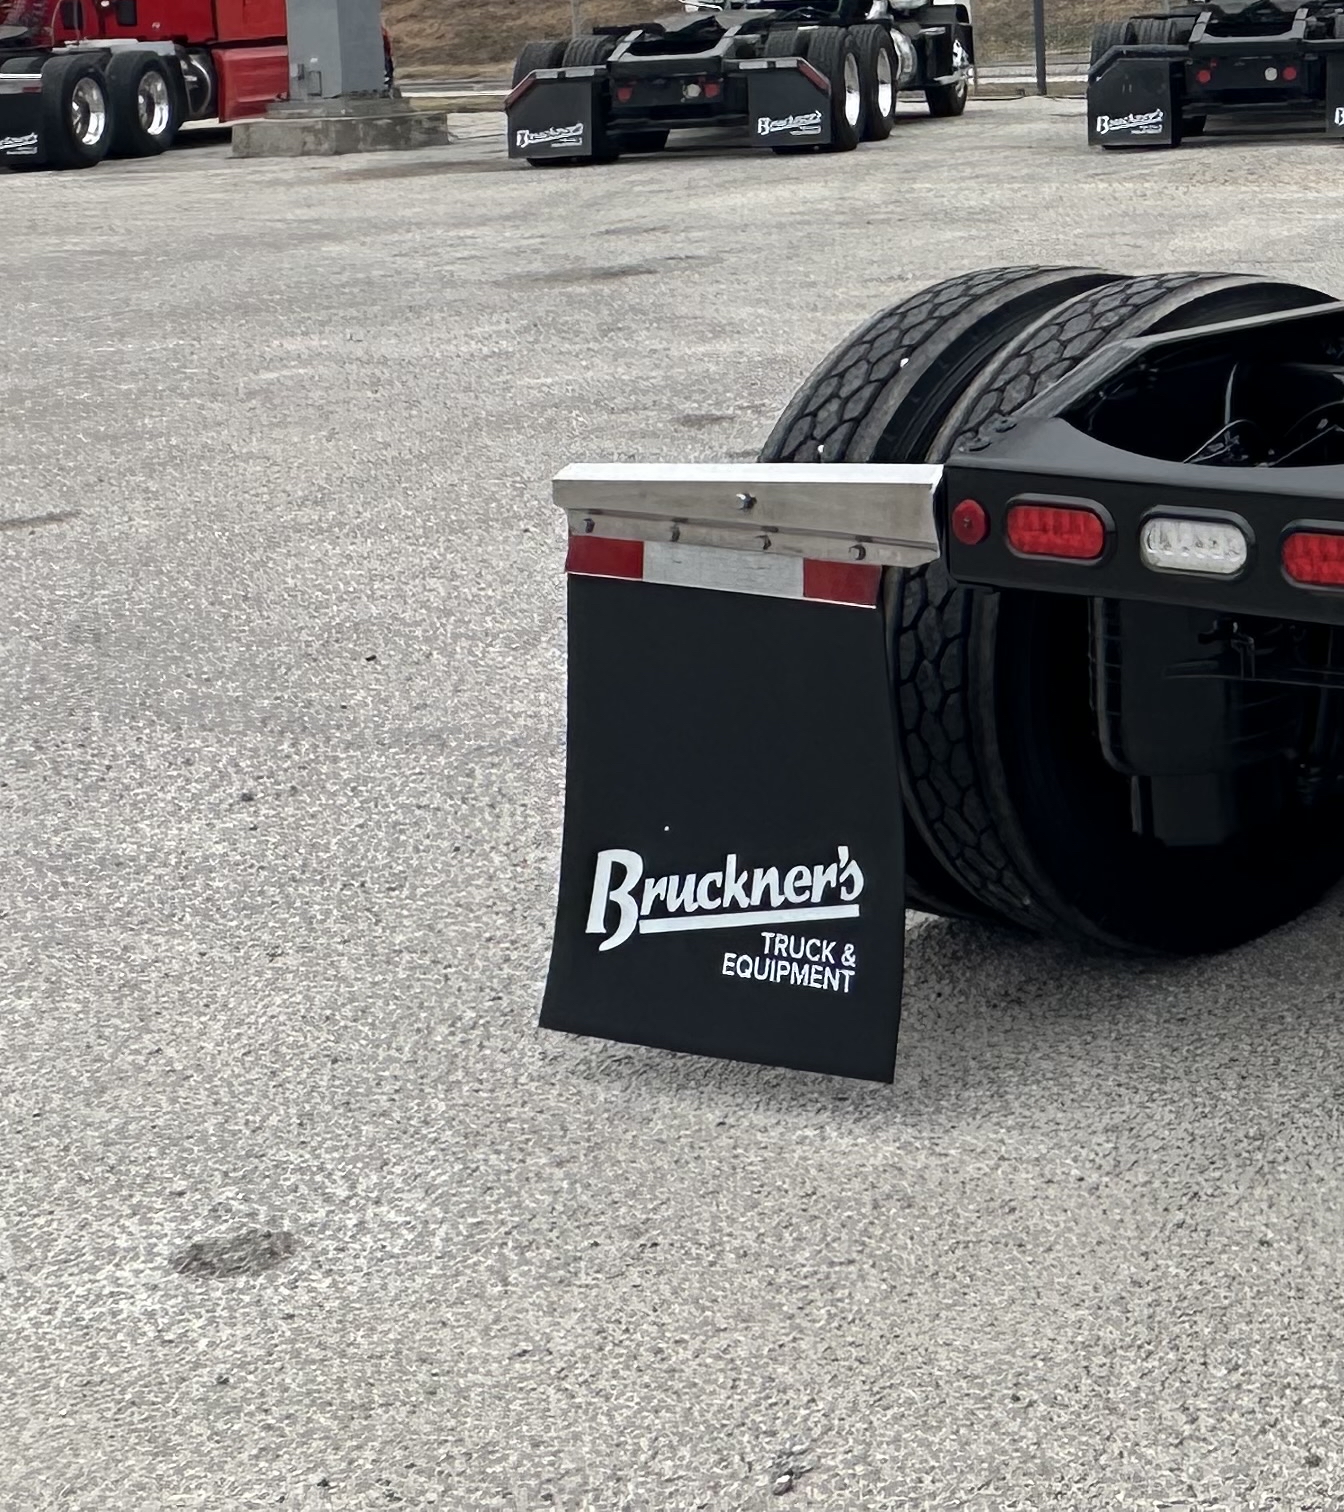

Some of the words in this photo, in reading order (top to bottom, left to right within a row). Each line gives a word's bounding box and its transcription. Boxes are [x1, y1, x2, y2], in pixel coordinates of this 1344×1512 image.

[585, 845, 864, 951] Bruckner's
[761, 932, 837, 964] TRUCK
[841, 944, 857, 968] &
[721, 952, 856, 993] EQUIPMENT
